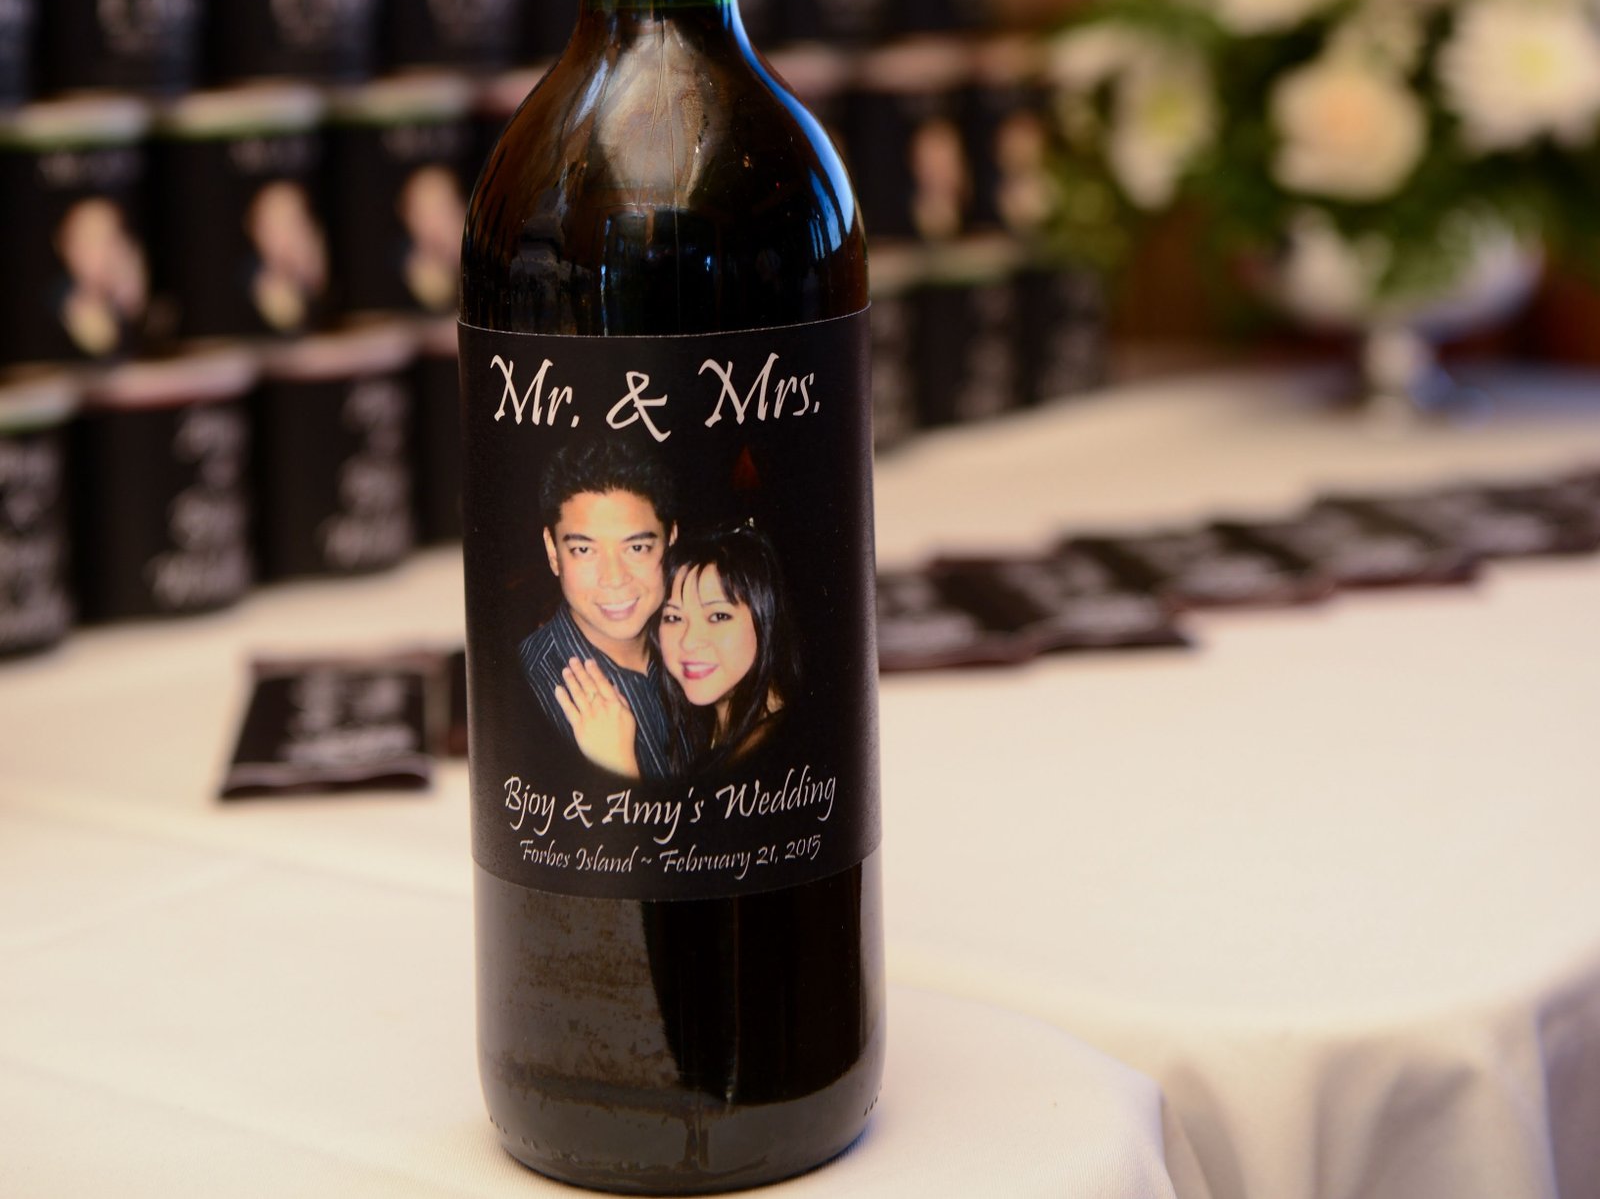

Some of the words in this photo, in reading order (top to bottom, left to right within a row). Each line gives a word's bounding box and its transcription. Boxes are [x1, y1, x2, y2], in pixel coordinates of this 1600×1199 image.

[490, 354, 580, 428] Mr.
[604, 370, 671, 443] &
[698, 352, 821, 428] Mrs.
[503, 775, 556, 836] Bjoy
[562, 790, 594, 829] &
[601, 786, 705, 845] Amy's
[715, 764, 837, 822] Wedding
[519, 839, 570, 869] Forbes
[575, 845, 634, 873] Island
[659, 848, 751, 880] February
[756, 844, 779, 866] 21,
[784, 834, 822, 862] 2015
